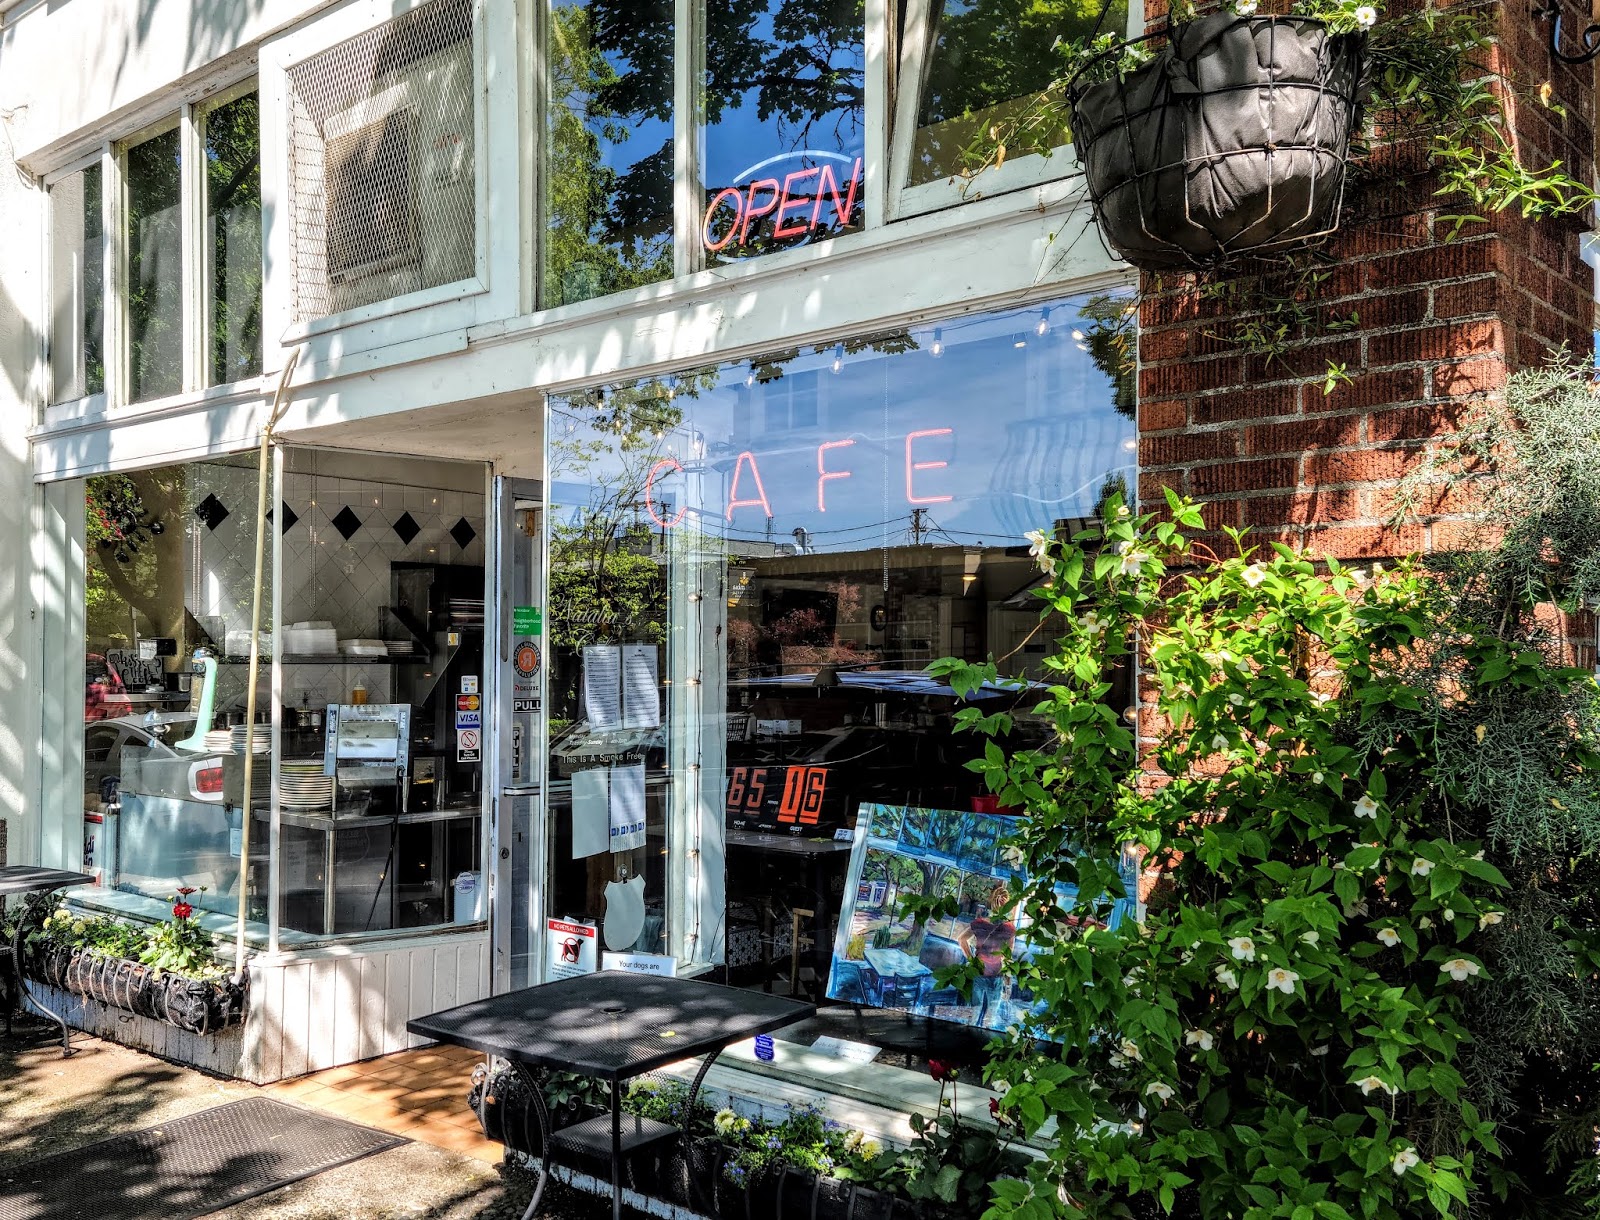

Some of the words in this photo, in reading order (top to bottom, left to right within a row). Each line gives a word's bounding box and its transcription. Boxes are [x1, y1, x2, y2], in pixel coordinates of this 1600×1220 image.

[702, 157, 862, 251] OPEN
[646, 428, 953, 527] CAFE
[514, 700, 541, 711] PULL
[460, 714, 479, 722] VISA
[512, 730, 520, 767] PULL
[563, 755, 577, 764] This
[590, 754, 596, 763] A
[599, 753, 624, 762] Smoke
[626, 751, 642, 761] Free
[727, 766, 767, 808] 65
[560, 924, 570, 932] PETS
[619, 960, 632, 968] Your
[633, 962, 649, 970] dogs
